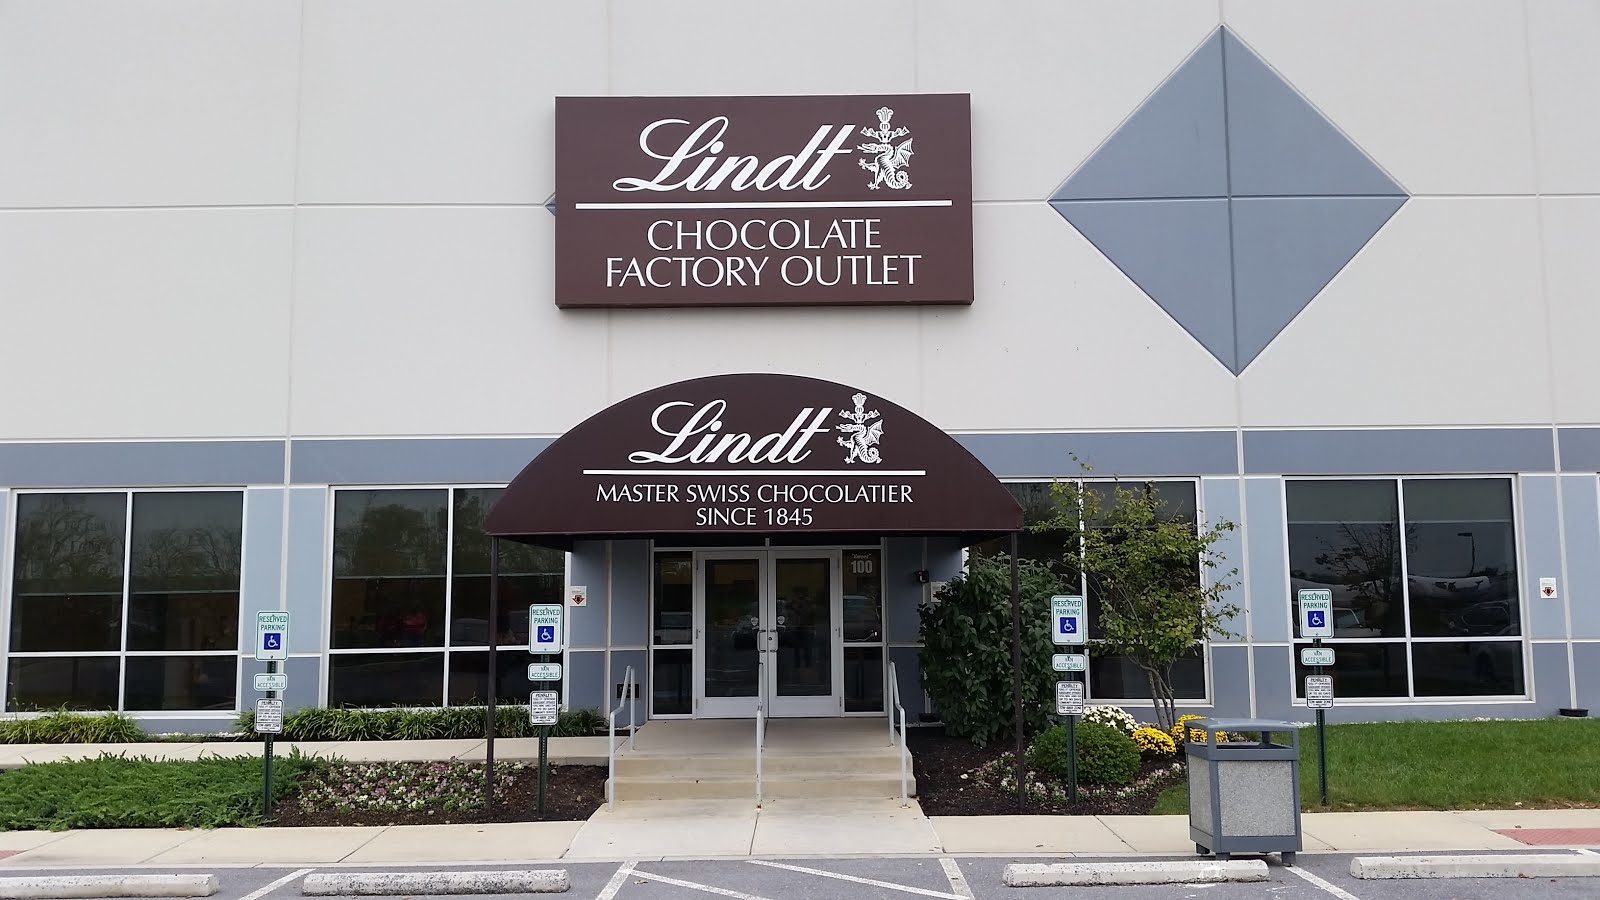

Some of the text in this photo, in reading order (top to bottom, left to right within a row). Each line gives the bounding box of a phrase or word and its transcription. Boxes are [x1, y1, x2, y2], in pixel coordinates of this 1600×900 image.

[612, 115, 856, 192] Lindt
[647, 218, 881, 250] CHOCOLATE
[606, 254, 922, 288] FACTORY OUTLET
[627, 399, 834, 464] Lindt
[596, 484, 914, 503] MASTER SWISS CHOCOLATIER
[696, 507, 813, 526] SINCE 1845
[850, 560, 873, 574] 100
[258, 615, 288, 623] RESERVED
